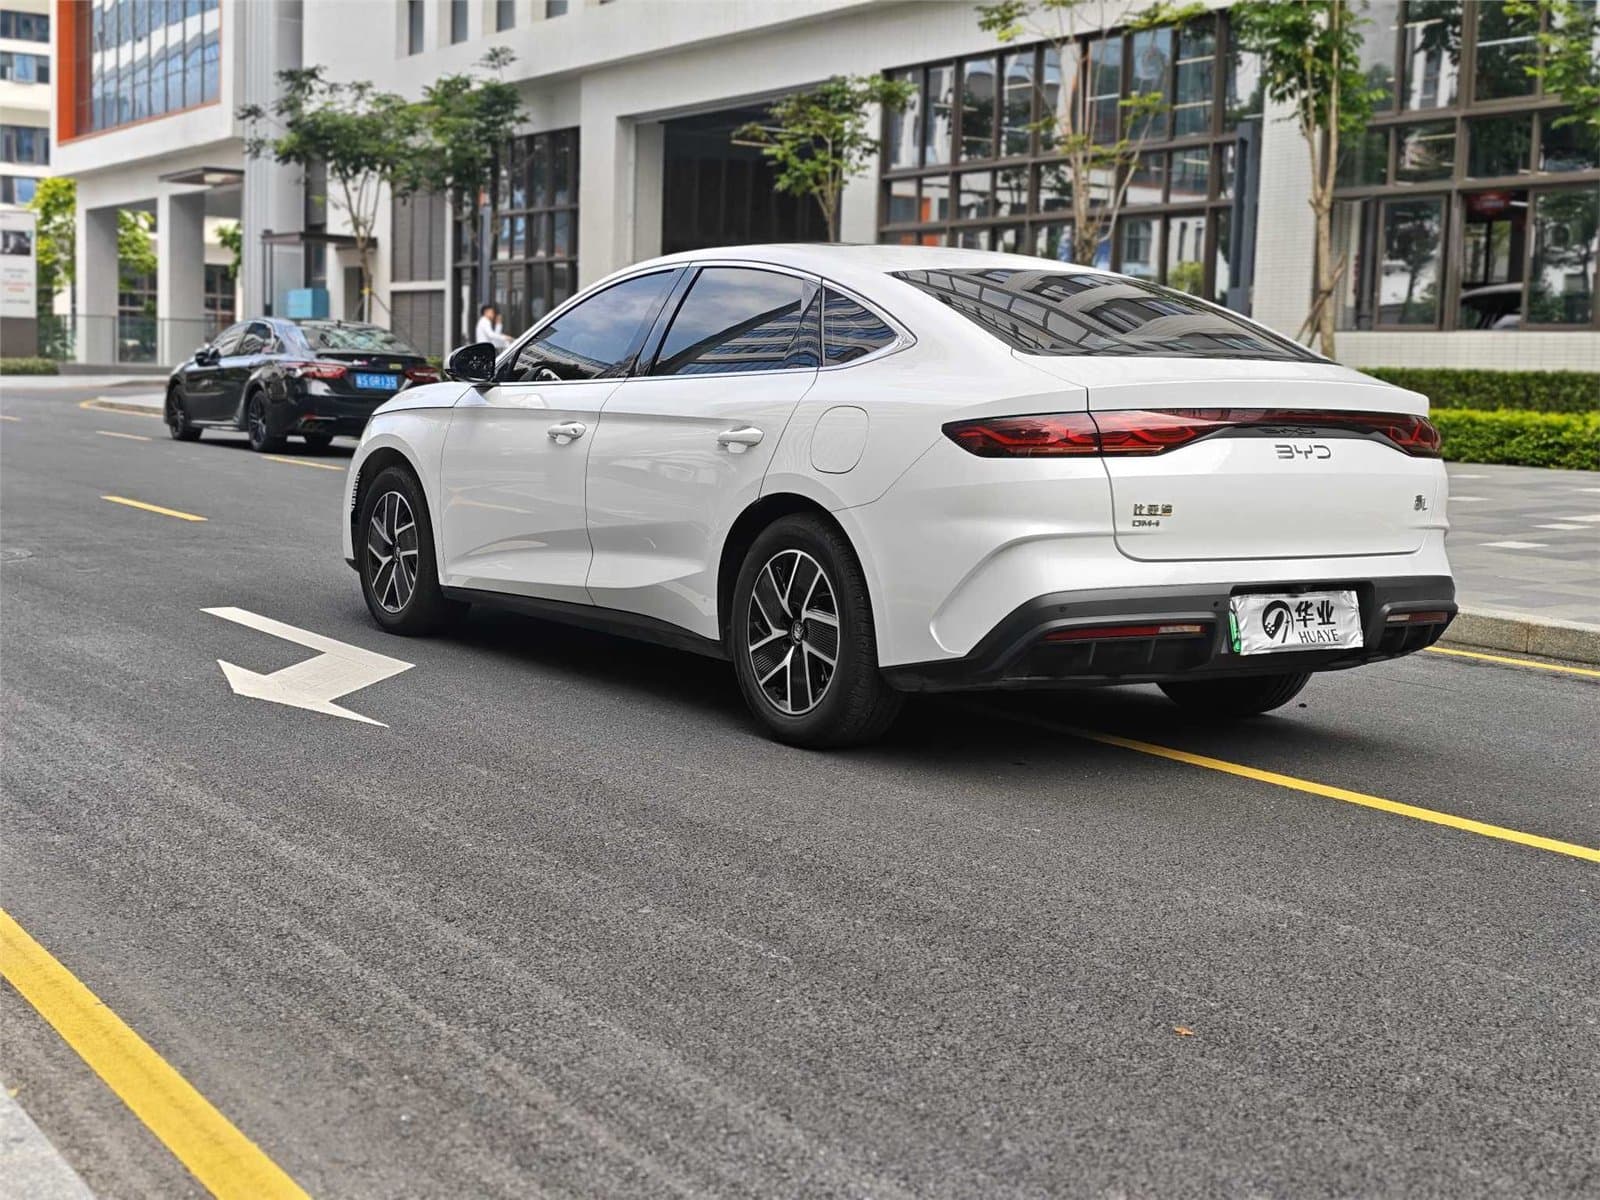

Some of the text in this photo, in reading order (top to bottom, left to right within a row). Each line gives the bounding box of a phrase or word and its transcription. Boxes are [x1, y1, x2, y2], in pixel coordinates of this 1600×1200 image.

[1275, 444, 1331, 459] BYD
[1295, 600, 1336, 628] 华业
[1298, 629, 1338, 644] HUAYE
